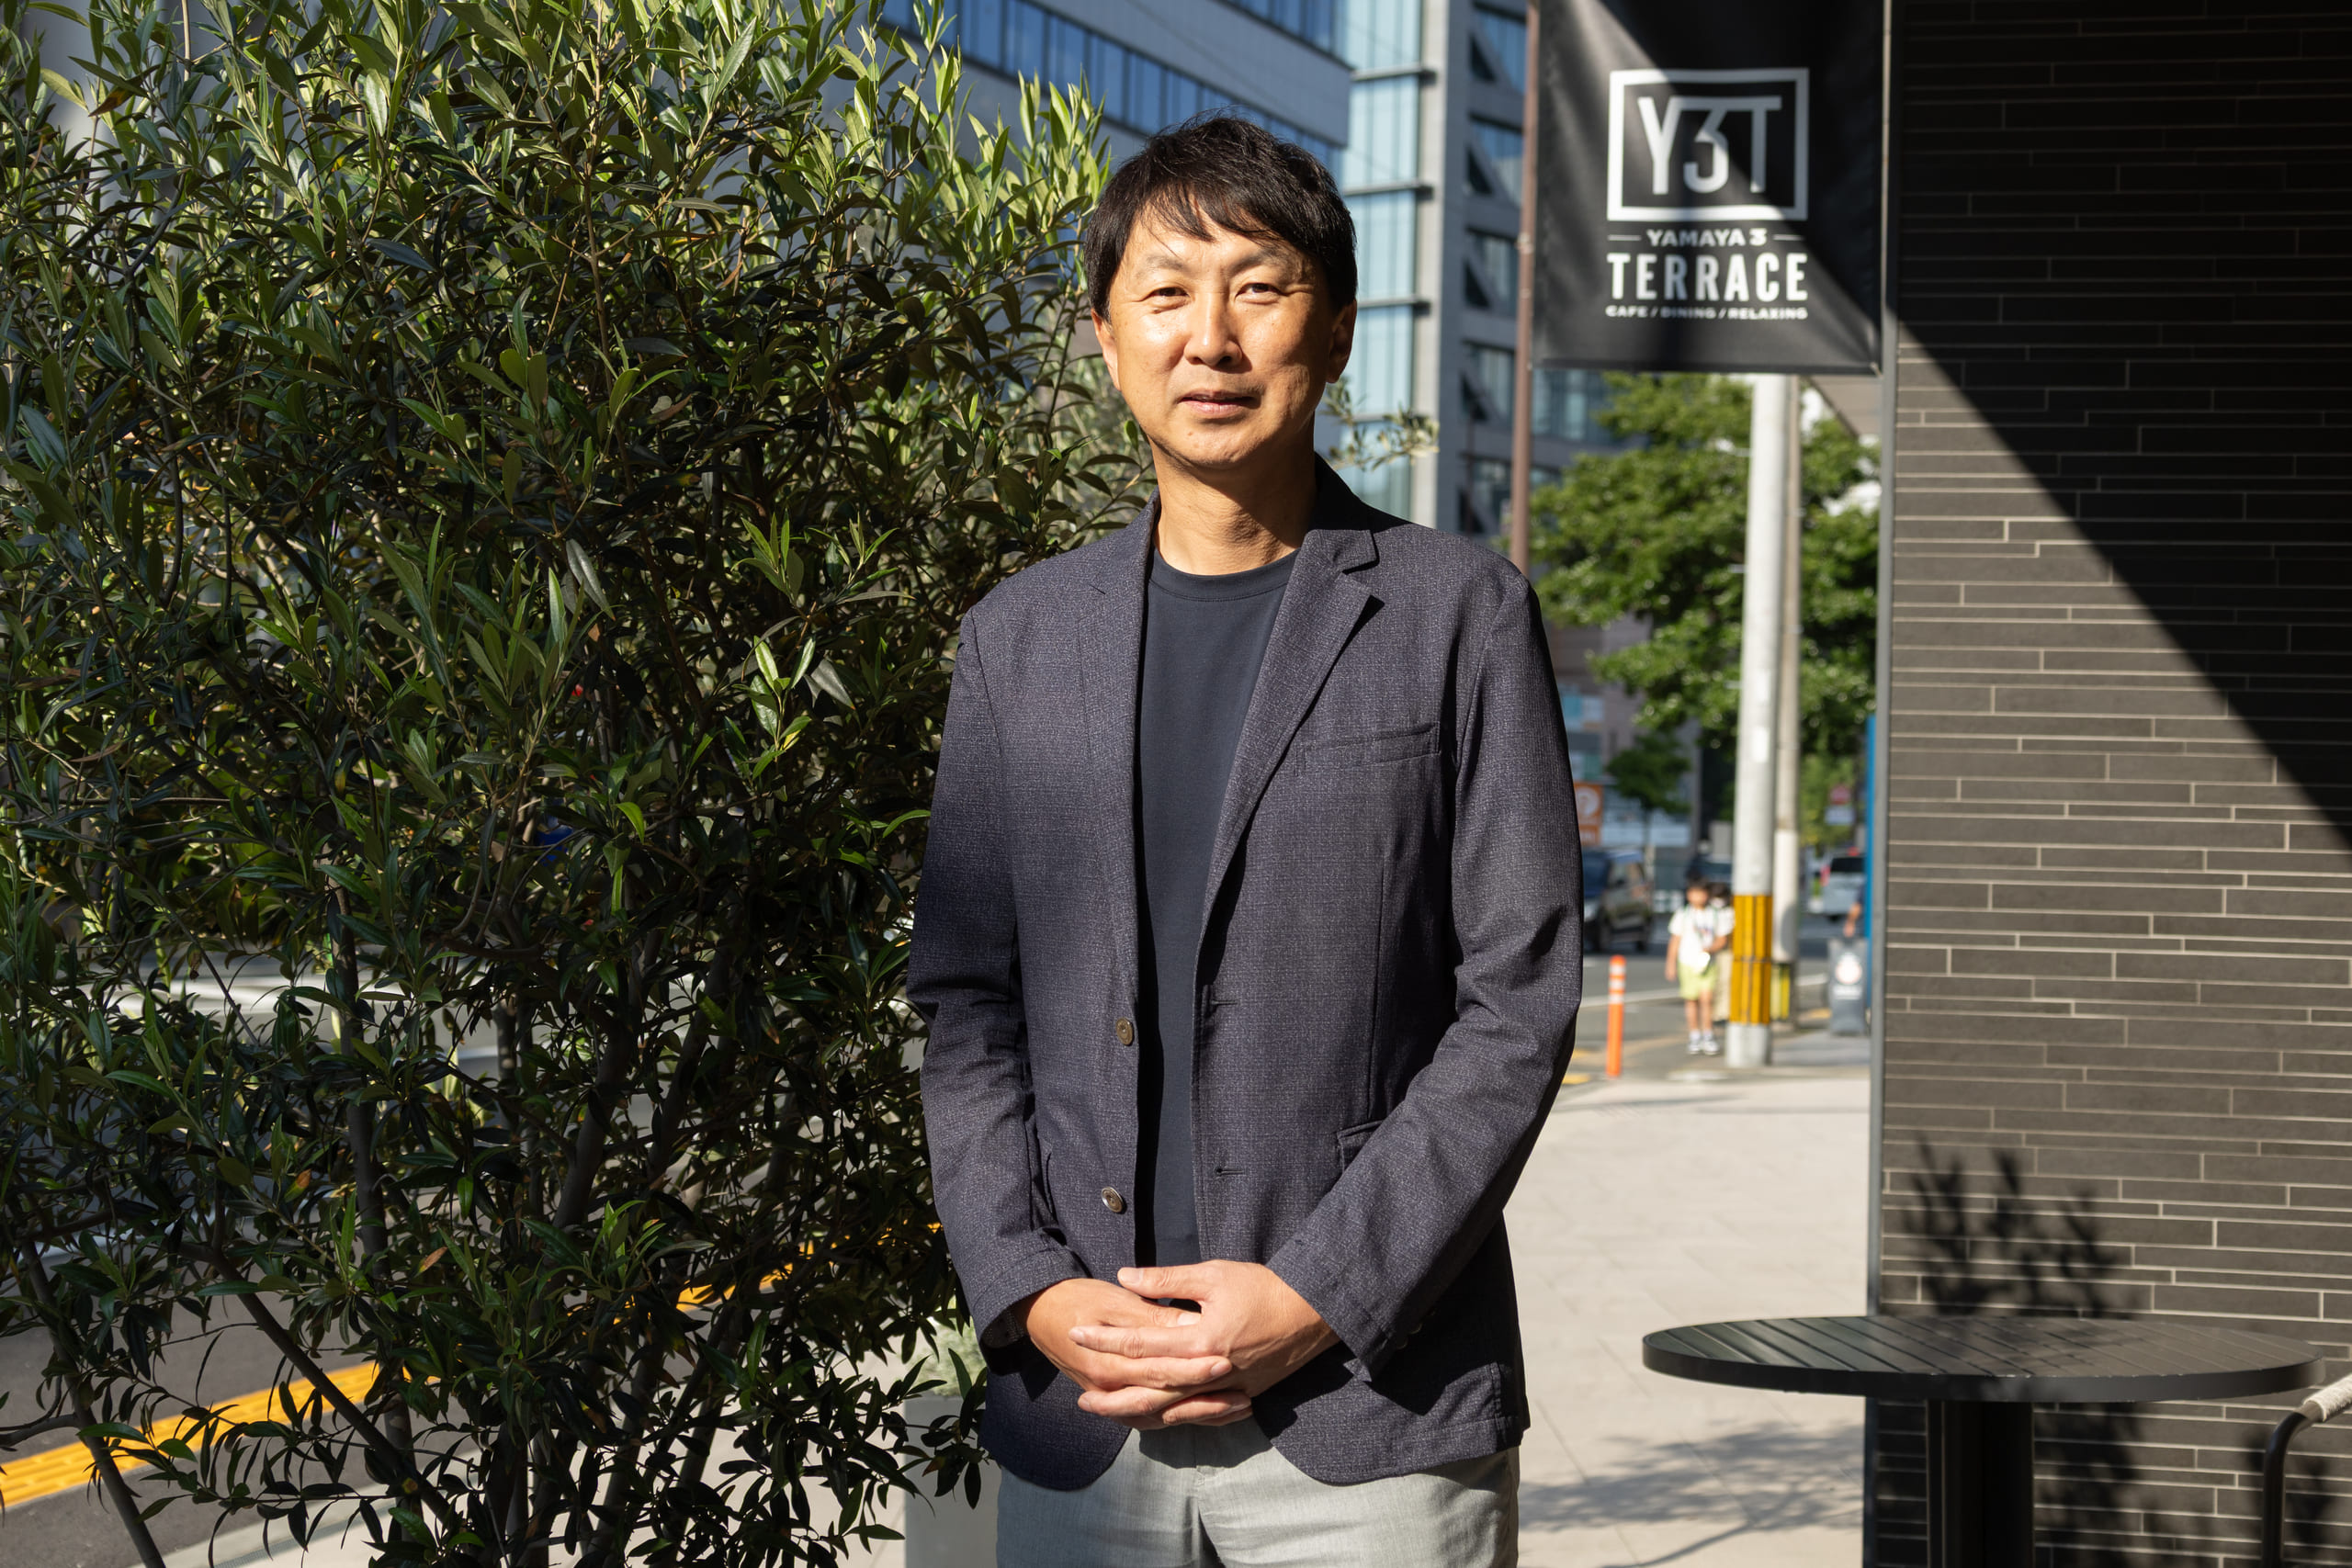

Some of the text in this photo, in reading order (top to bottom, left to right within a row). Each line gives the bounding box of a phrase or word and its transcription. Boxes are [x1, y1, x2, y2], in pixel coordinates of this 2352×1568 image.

[1638, 96, 1781, 195] Y3T
[1646, 229, 1767, 246] YAMAYA 3
[1607, 253, 1807, 301] TERRACE
[1605, 305, 1647, 318] CAFE
[1660, 307, 1716, 319] DINING
[1727, 307, 1808, 320] RELAXING
